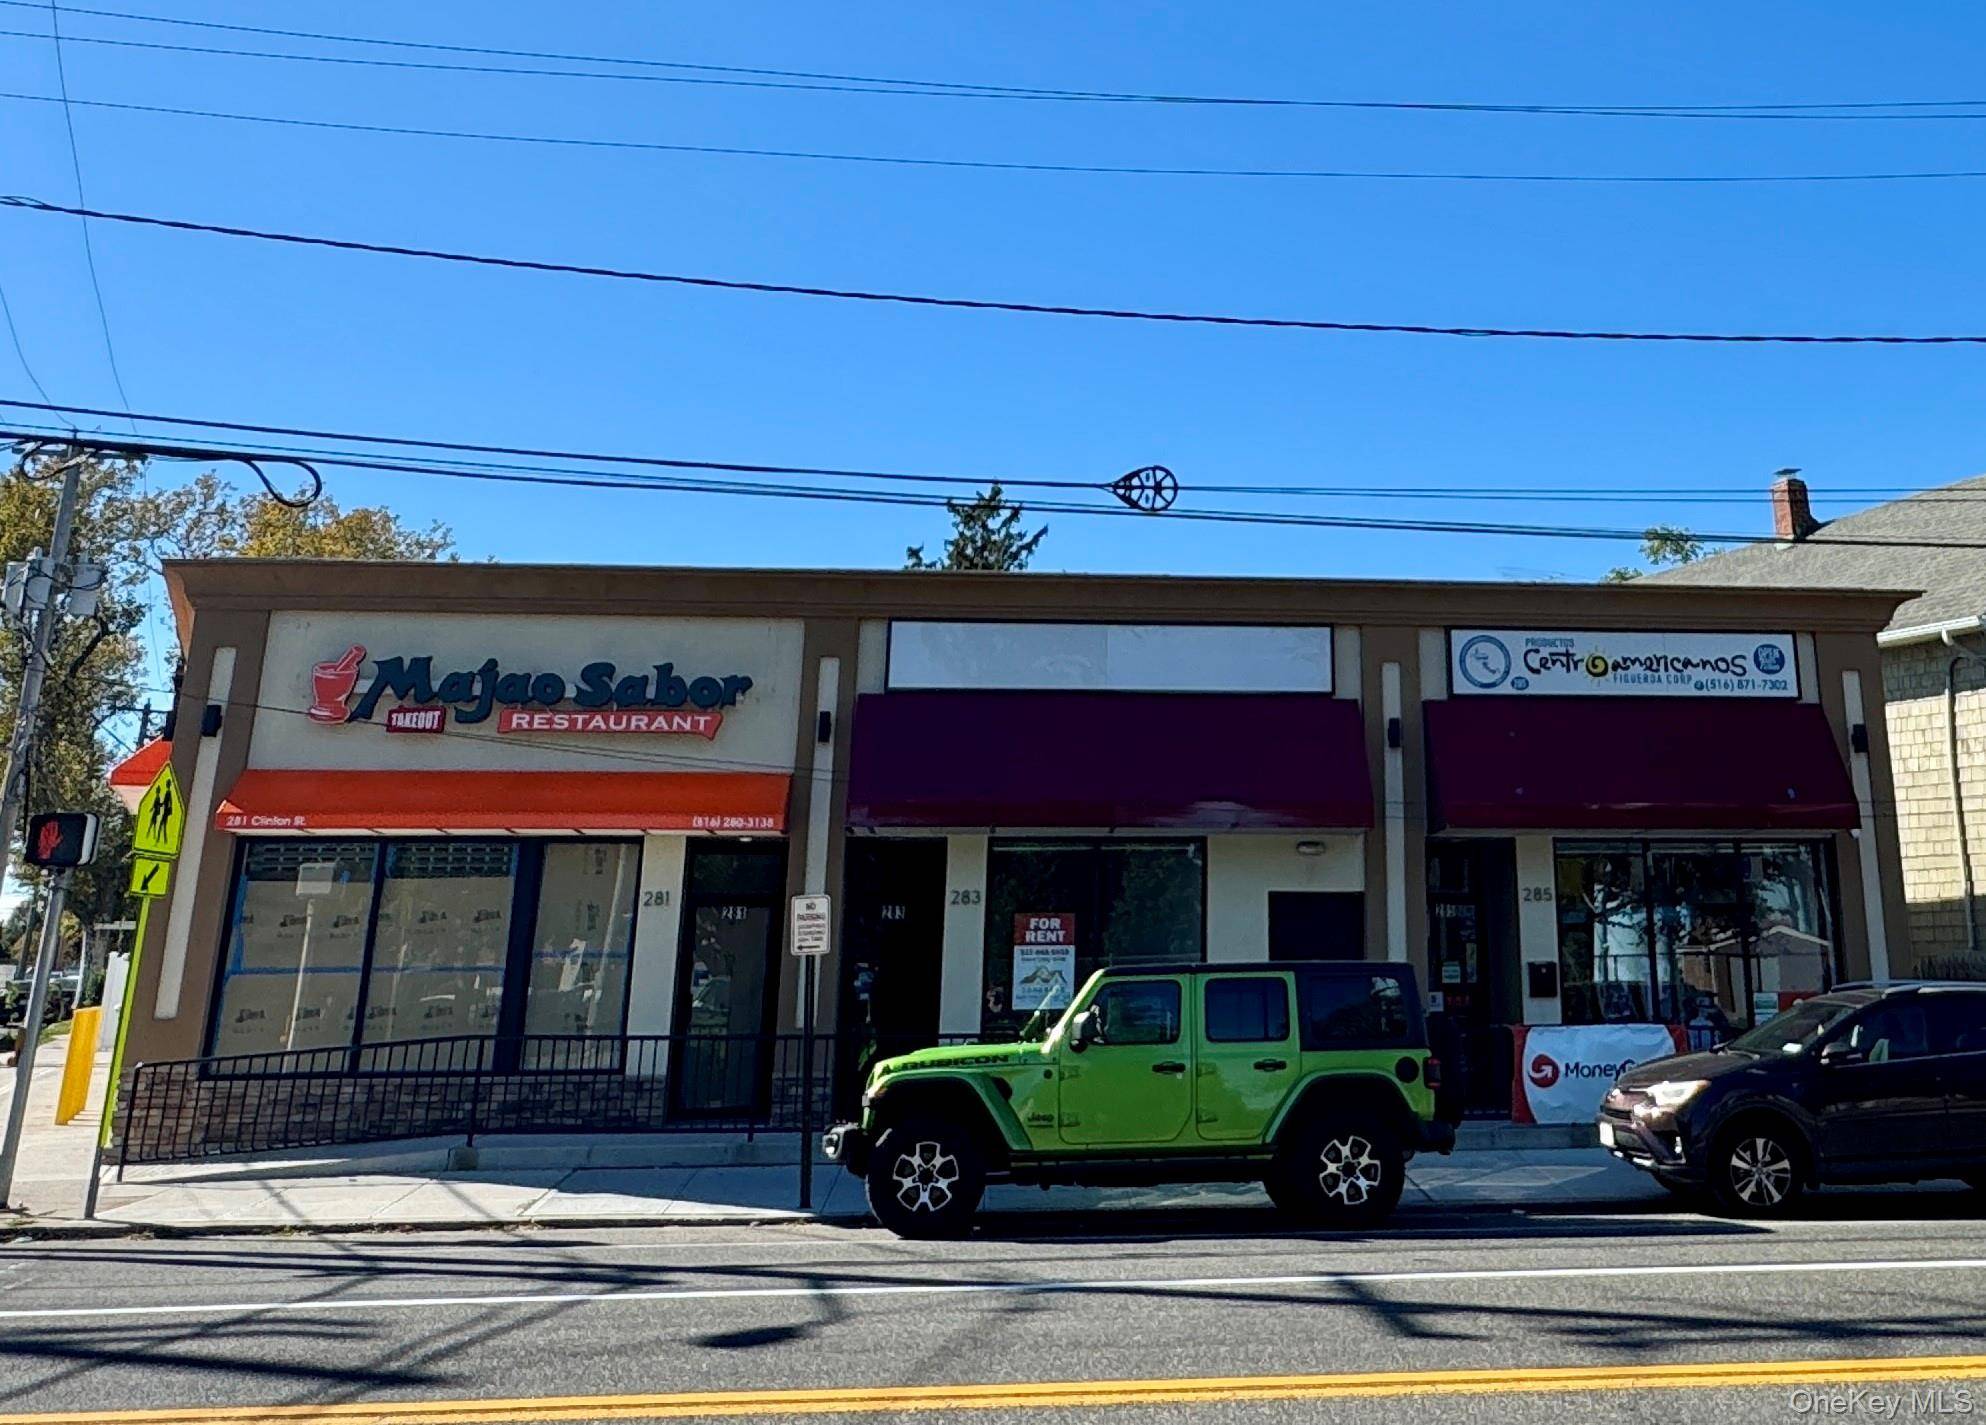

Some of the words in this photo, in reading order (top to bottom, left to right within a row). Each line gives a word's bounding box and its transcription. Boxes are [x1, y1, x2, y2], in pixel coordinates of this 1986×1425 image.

[1613, 673, 1662, 684] FIGUEROA
[1666, 675, 1692, 685] CORP
[1705, 679, 1734, 692] (516)
[348, 656, 566, 723] Majao
[573, 662, 753, 709] Sabor
[391, 710, 440, 729] TAKEOUT
[510, 713, 712, 733] RESTAURANT
[251, 816, 291, 826] Clinton
[643, 891, 670, 907] 281
[951, 889, 981, 905] 283
[1522, 887, 1553, 902] 285
[806, 903, 816, 911] NO
[1029, 917, 1061, 930] FOR
[1025, 930, 1066, 943] RENT
